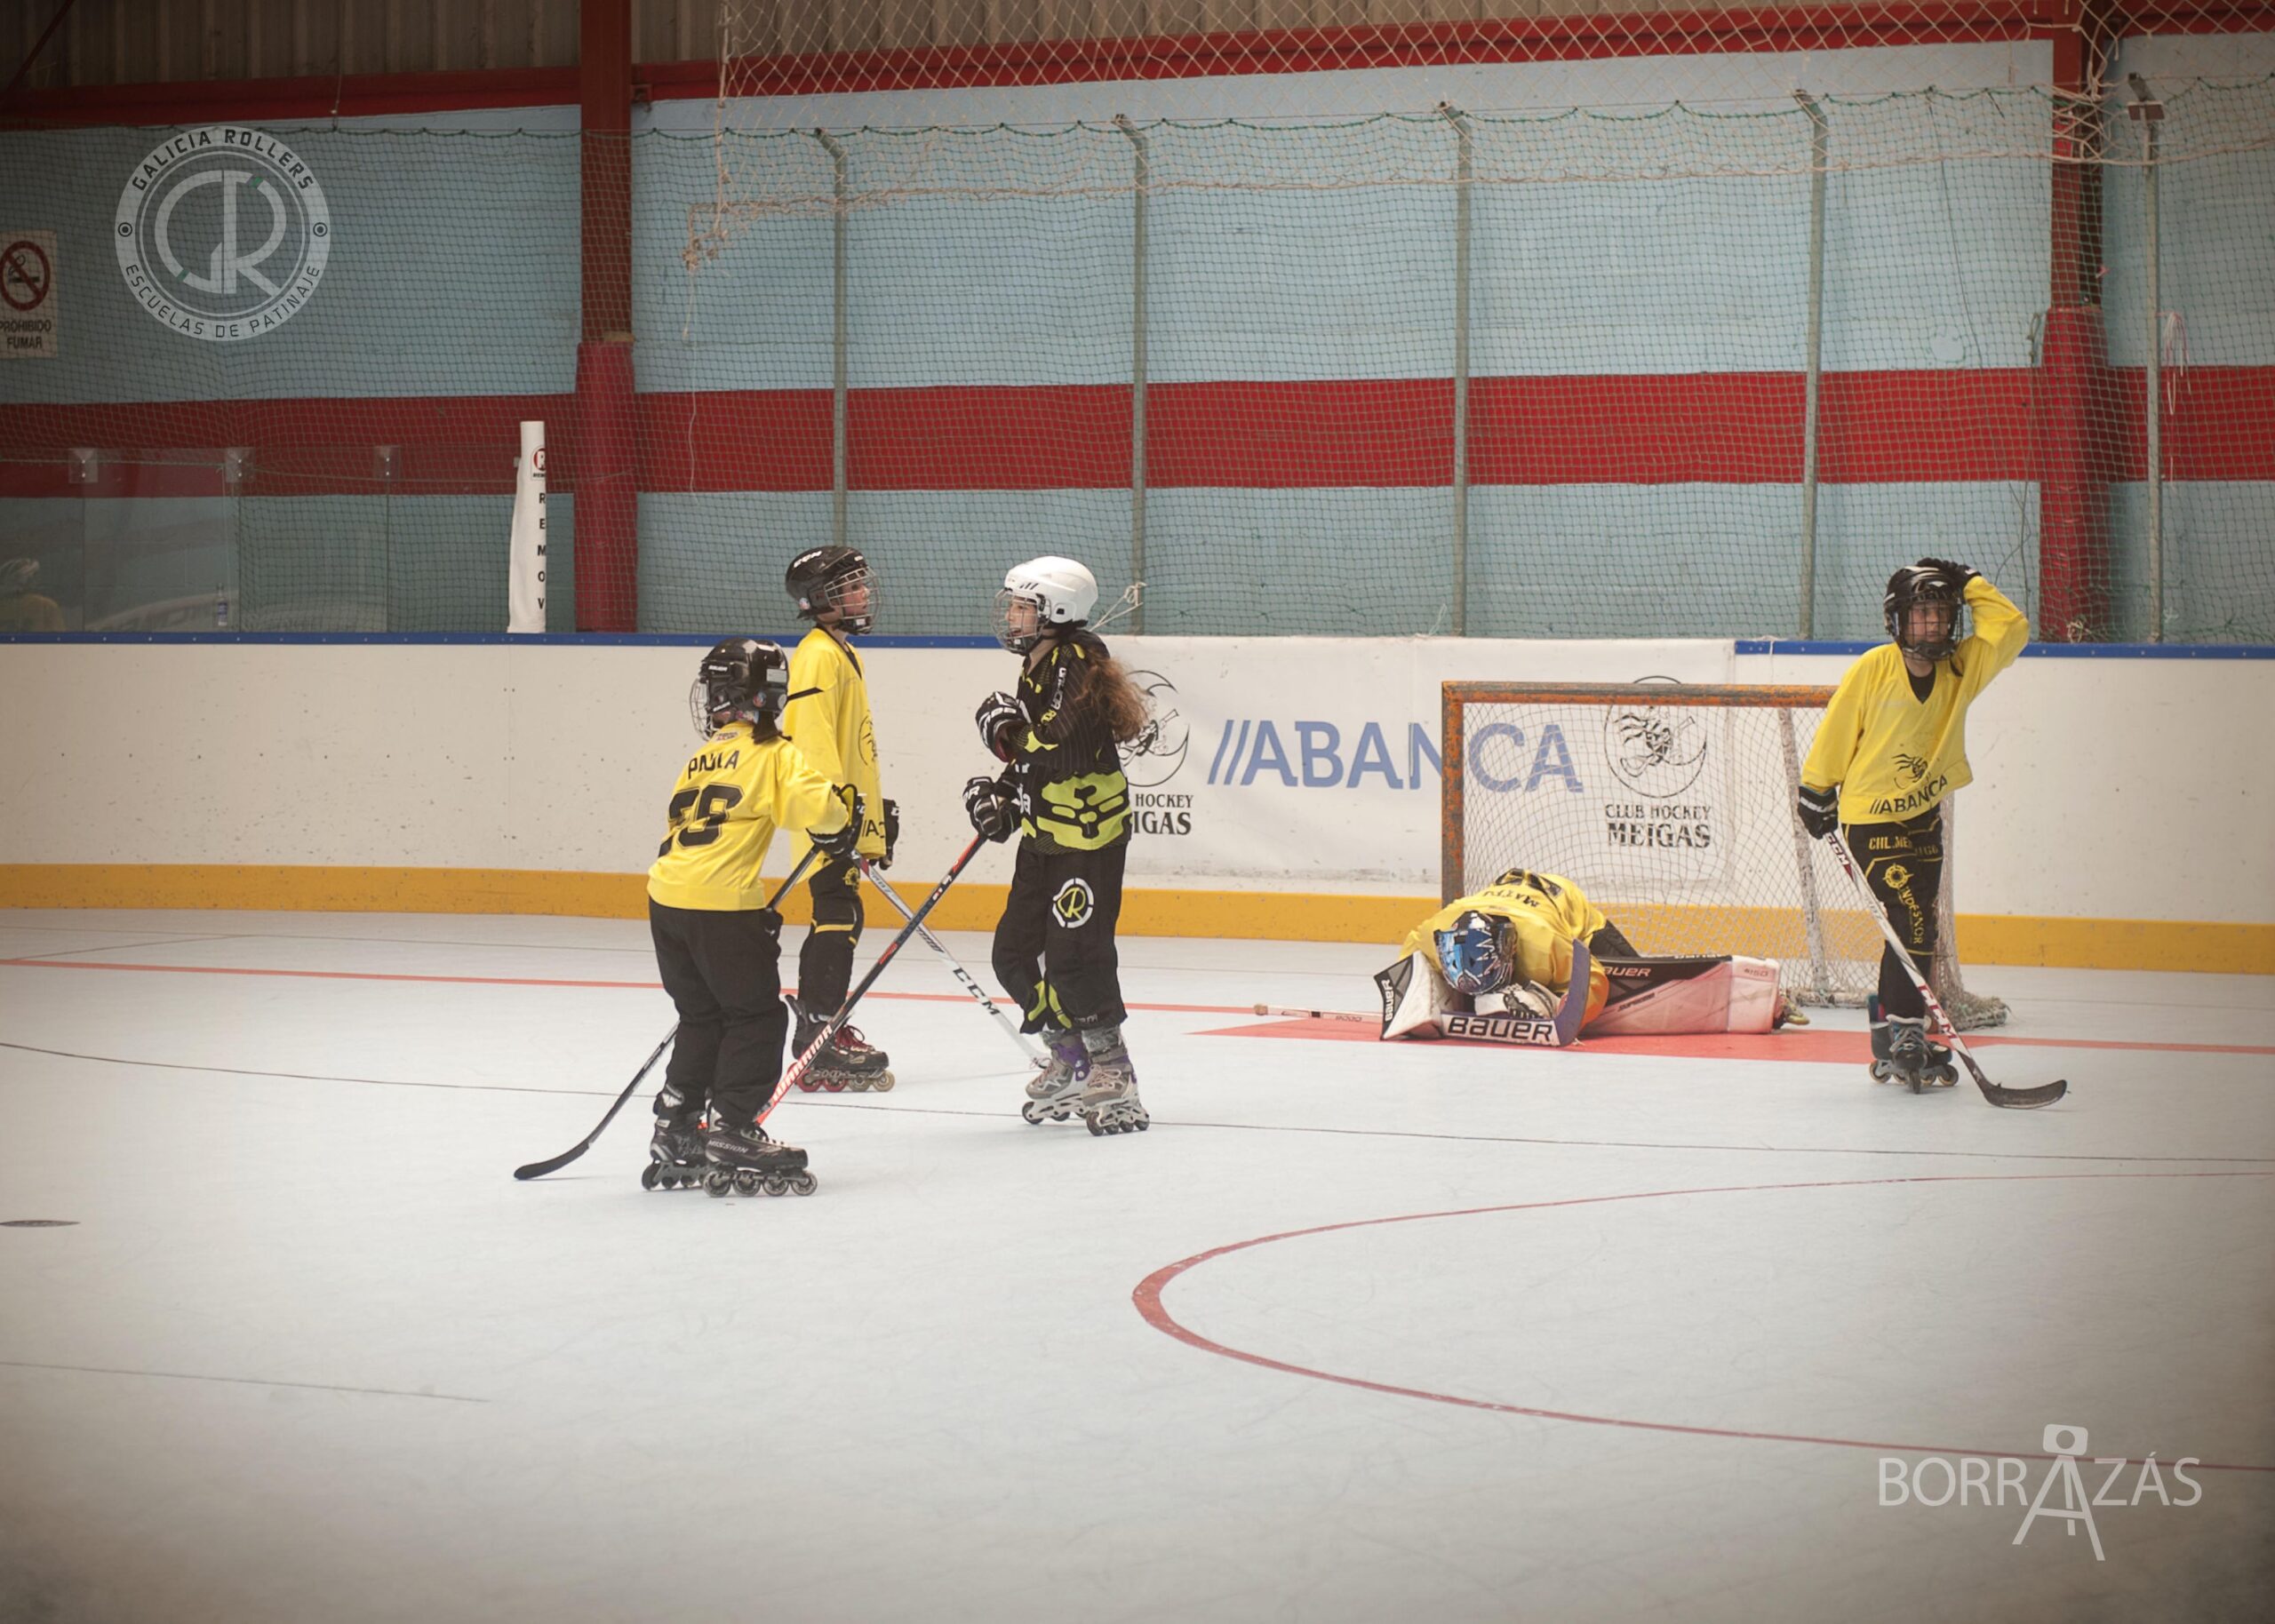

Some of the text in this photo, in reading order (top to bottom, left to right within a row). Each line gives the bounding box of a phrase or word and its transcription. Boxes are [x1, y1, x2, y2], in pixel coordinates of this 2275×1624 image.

[7, 336, 44, 350] FUMAR
[1135, 793, 1194, 808] HOCKEY
[1604, 803, 1713, 822] CLUB HOCKEY
[1133, 810, 1192, 836] IGAS
[1607, 822, 1712, 849] MEIGAS
[1605, 966, 1652, 978] AUER
[953, 967, 1001, 1015] CCM
[1384, 978, 1397, 1022] BAUER
[1447, 1016, 1554, 1042] BAUER
[770, 1023, 834, 1103] WARRIOR
[707, 1139, 750, 1153] MISSION
